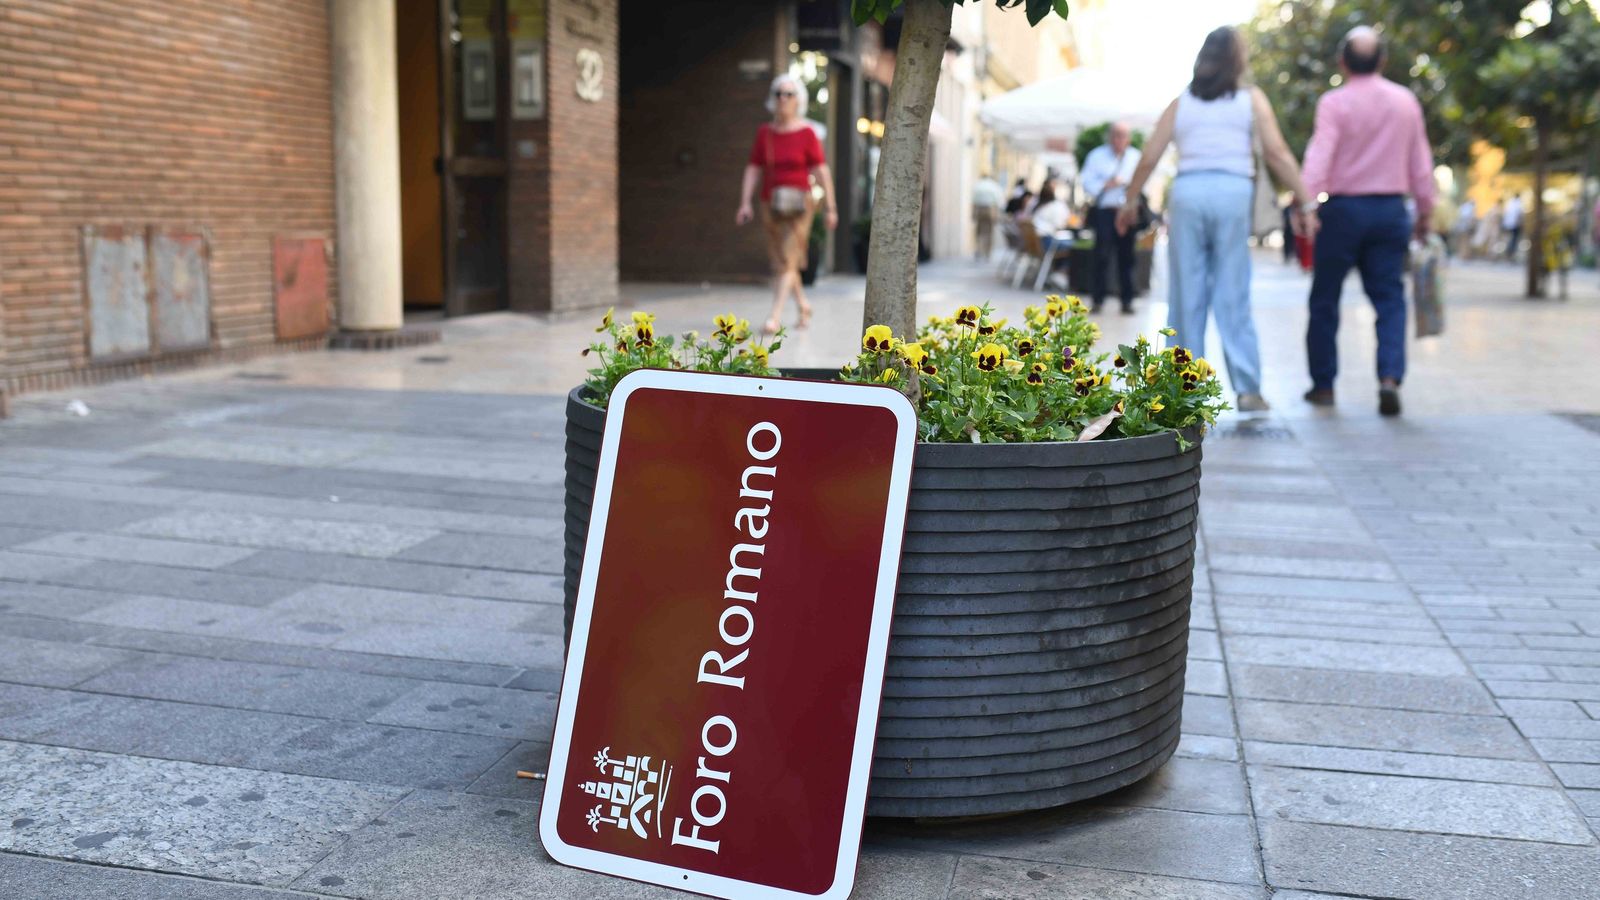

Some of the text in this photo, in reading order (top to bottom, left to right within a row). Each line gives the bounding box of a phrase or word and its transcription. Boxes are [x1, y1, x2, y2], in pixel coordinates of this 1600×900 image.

[575, 48, 604, 102] 32
[671, 422, 781, 854] Foro Romano
